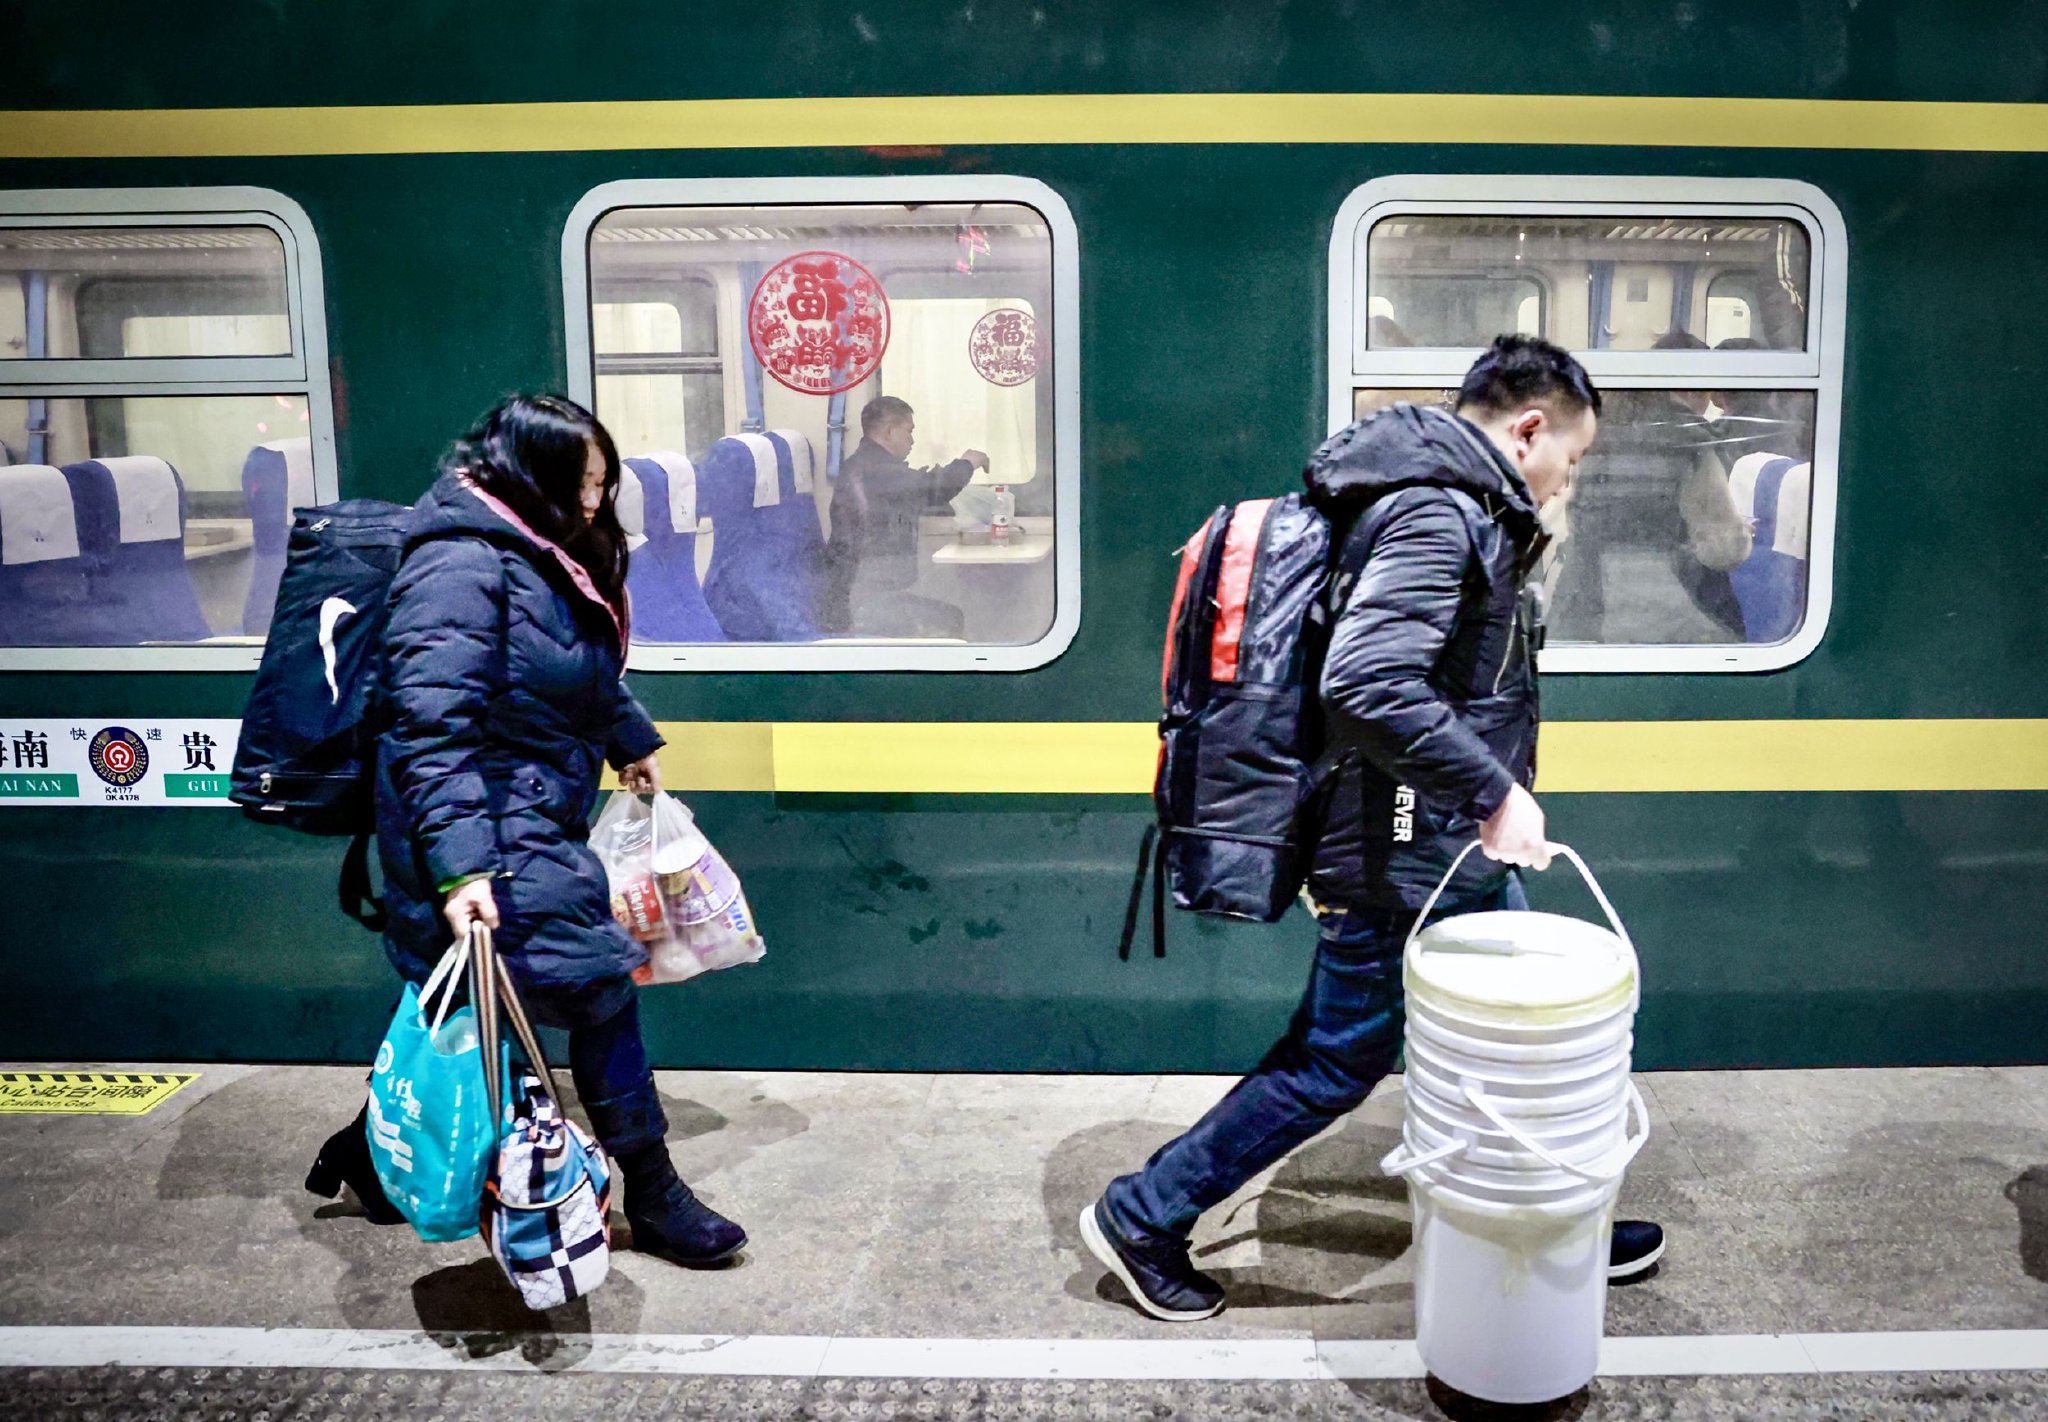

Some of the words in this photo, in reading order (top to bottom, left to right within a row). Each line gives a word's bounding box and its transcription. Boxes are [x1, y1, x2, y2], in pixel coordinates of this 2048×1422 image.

[991, 313, 1025, 346] 福
[70, 727, 88, 741] 快
[146, 727, 163, 741] 速
[0, 729, 49, 769] 南
[178, 731, 218, 771] 贵
[0, 780, 18, 792] AI
[26, 780, 62, 792] NAN
[188, 780, 220, 793] GUI
